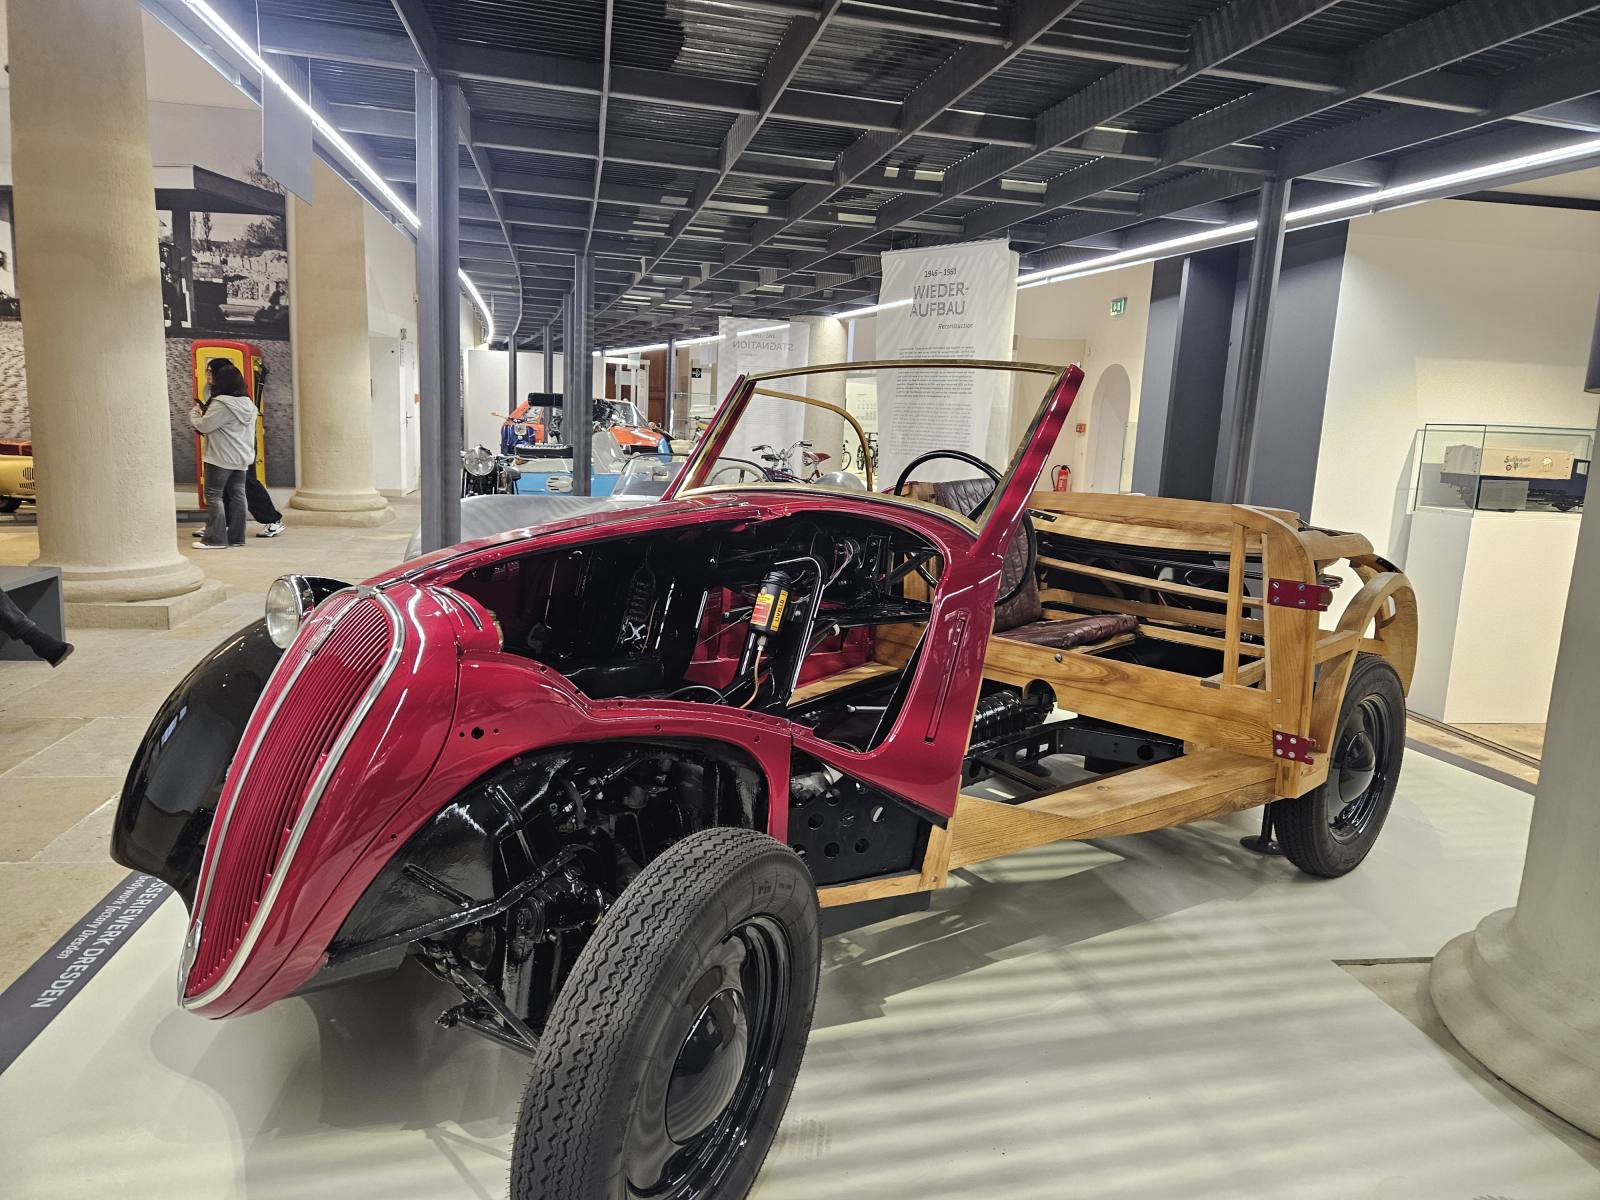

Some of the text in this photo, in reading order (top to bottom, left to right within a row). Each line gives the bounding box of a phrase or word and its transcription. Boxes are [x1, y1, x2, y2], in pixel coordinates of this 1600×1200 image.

[913, 281, 969, 300] WIEDER-
[909, 300, 966, 318] AUFBAU
[86, 904, 122, 932] factory
[30, 878, 168, 1008] SSERIEWERK DRESDEN
[56, 929, 98, 959] Dresden
